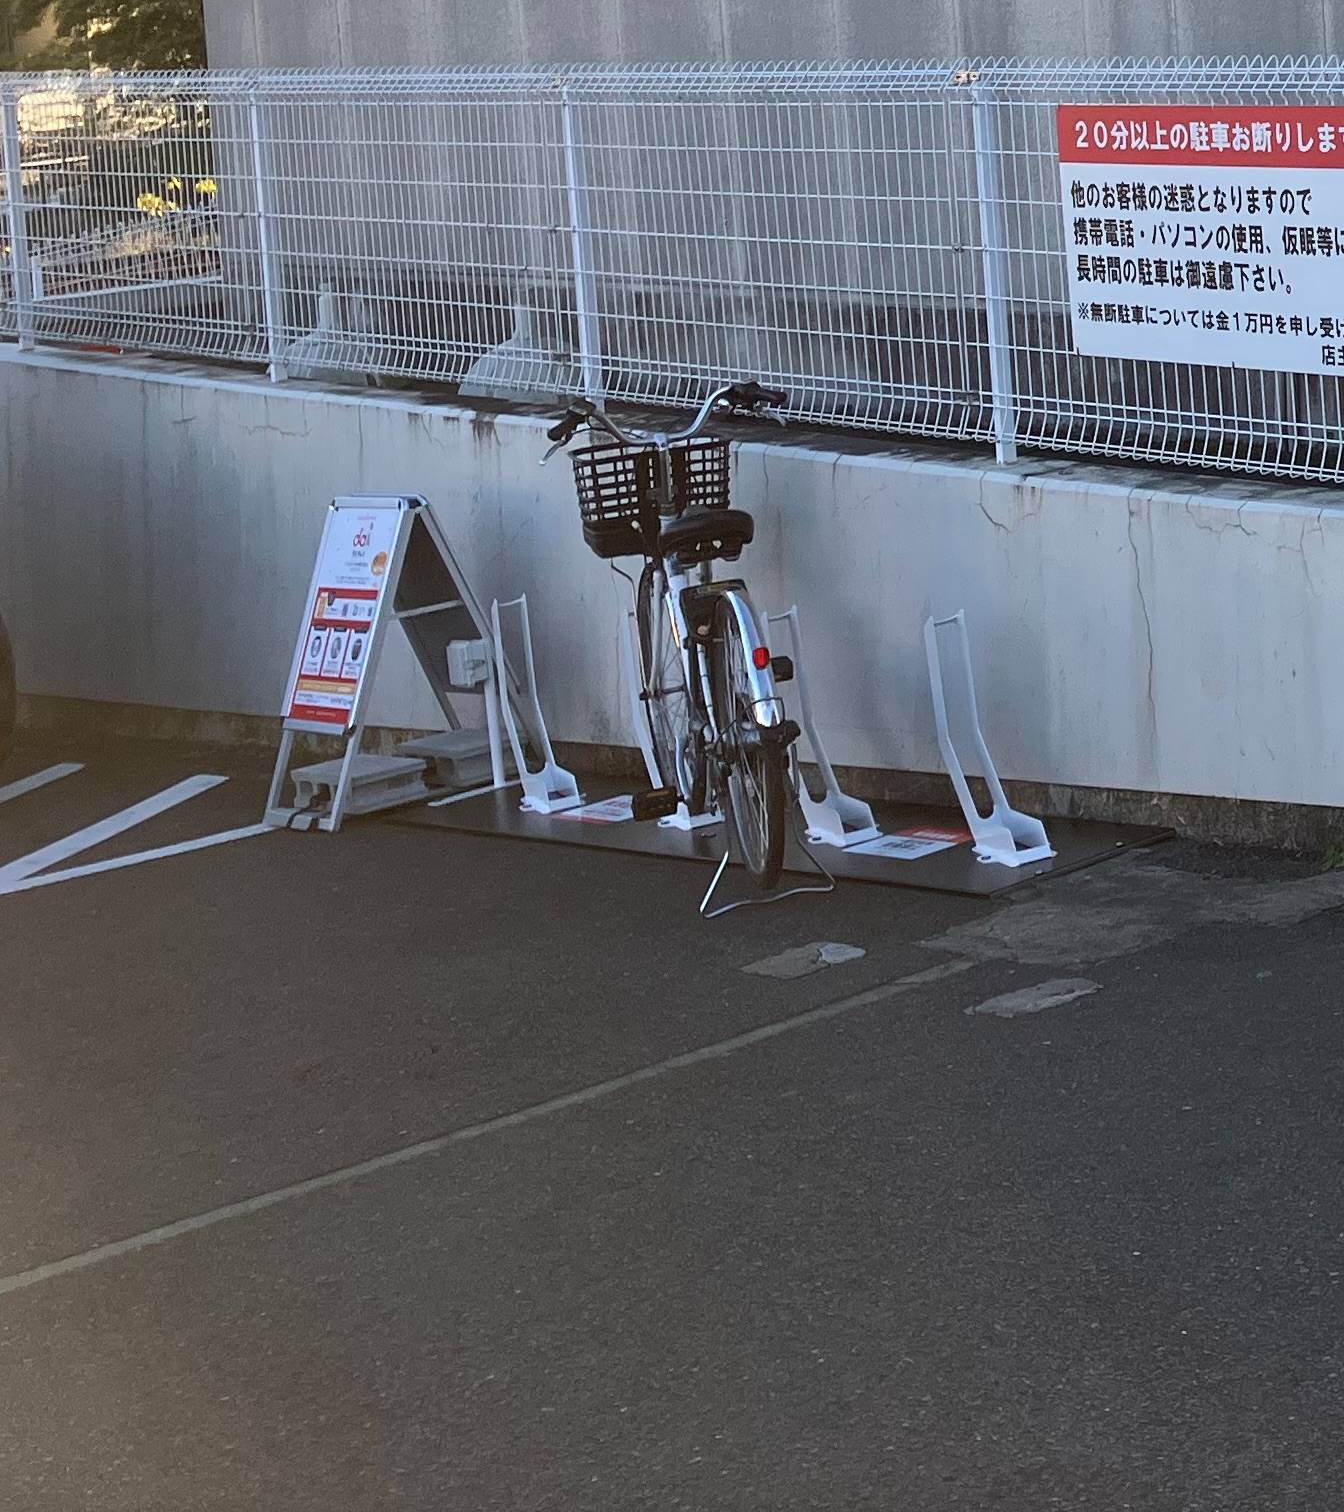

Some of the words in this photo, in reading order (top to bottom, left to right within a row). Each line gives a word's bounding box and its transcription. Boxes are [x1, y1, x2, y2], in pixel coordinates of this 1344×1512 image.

[1071, 180, 1313, 216] 他のお客様の迷惑となりますので
[1076, 254, 1293, 295] 長時間の駐車は御遠慮下さい。
